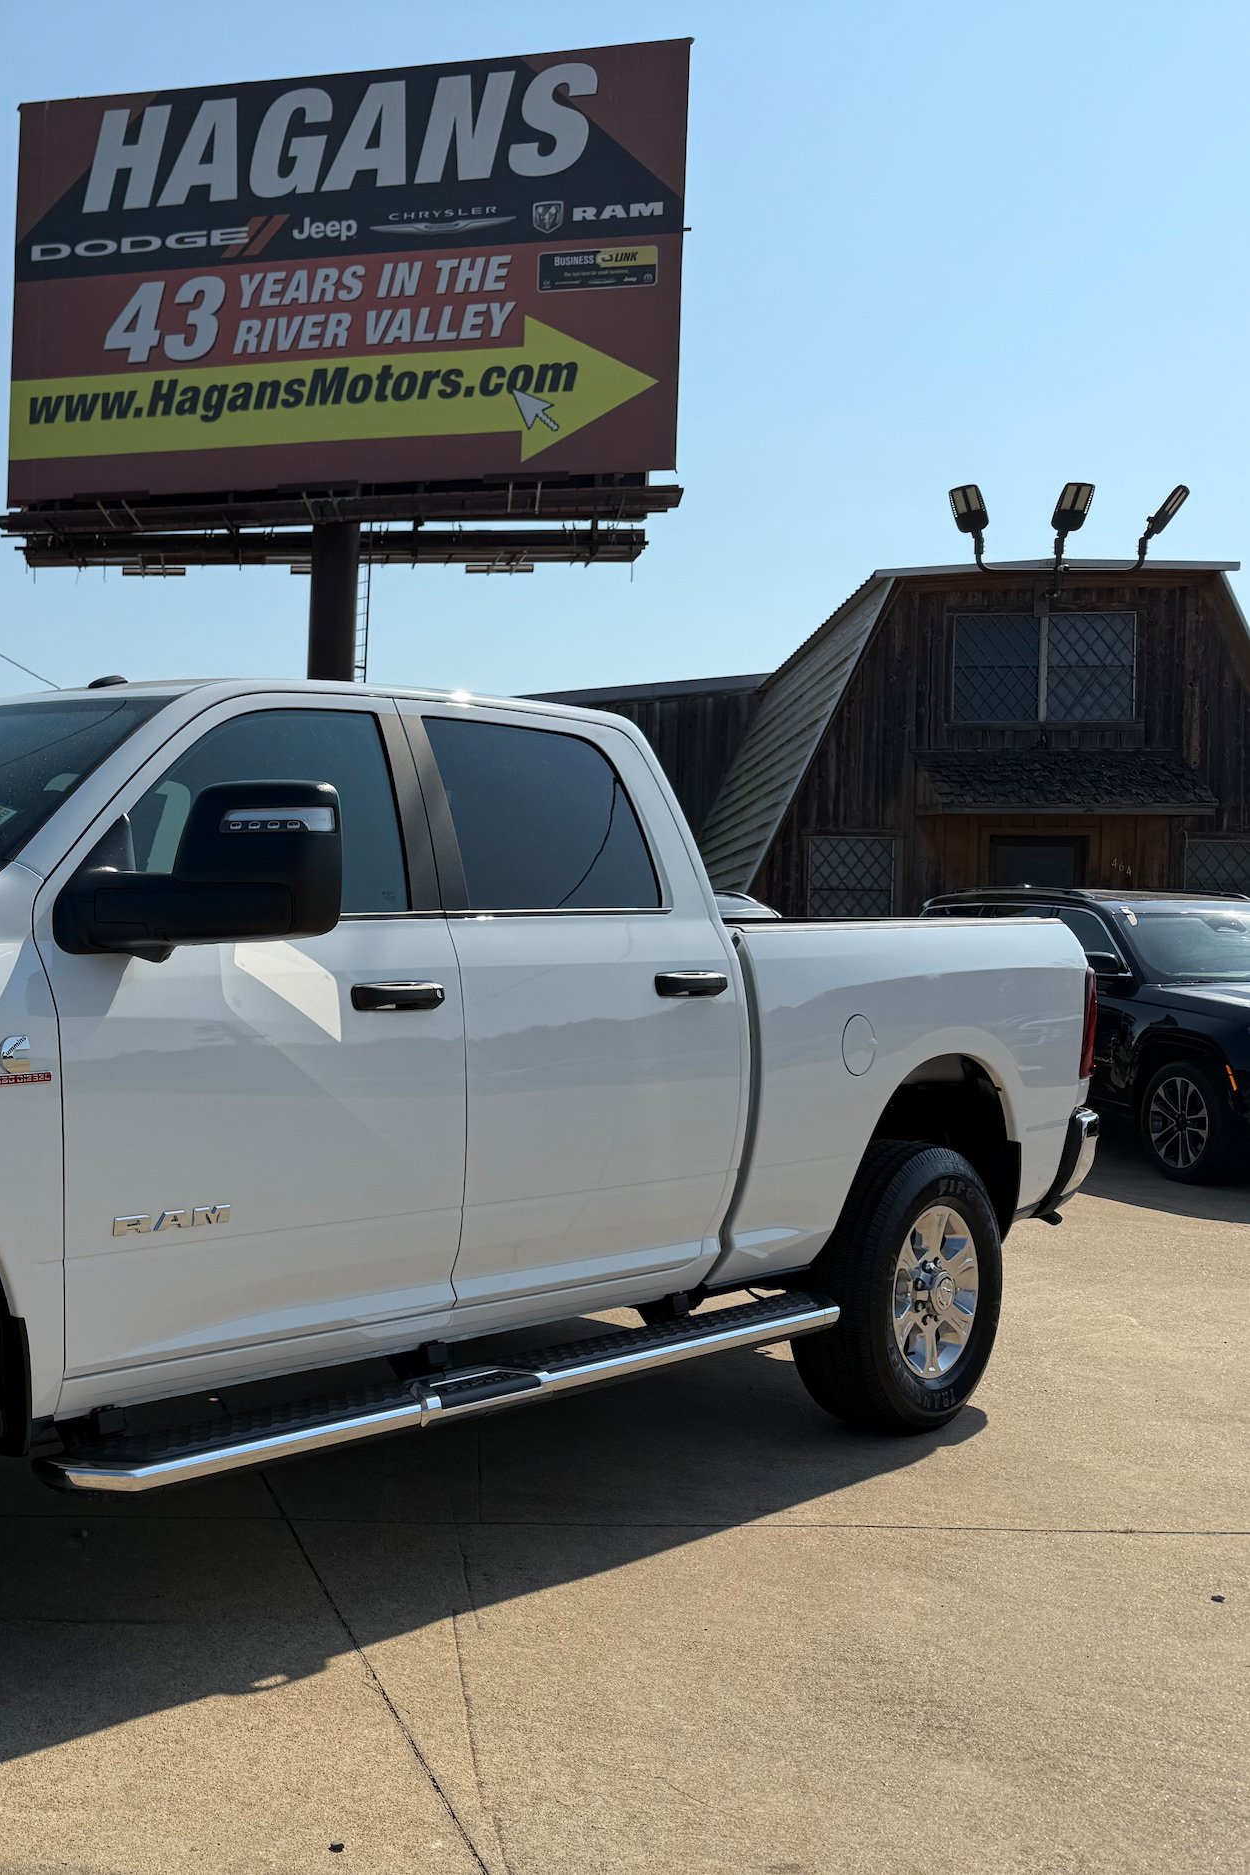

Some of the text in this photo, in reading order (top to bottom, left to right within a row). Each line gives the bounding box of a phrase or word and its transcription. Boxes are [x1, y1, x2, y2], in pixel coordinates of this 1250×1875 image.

[81, 62, 599, 214] HAGANS
[388, 205, 498, 222] CHRYSLER
[572, 201, 664, 221] RAM
[31, 226, 249, 262] DODGE
[292, 216, 358, 242] Jeep
[554, 251, 639, 267] BUSINESS LINK
[238, 255, 512, 309] YEARS IN THE
[103, 275, 226, 364] 43
[233, 301, 517, 355] RIVER VALLEY
[28, 360, 579, 426] www.HagansMotors.com
[1, 1036, 28, 1058] Cummins
[17, 1073, 50, 1082] DIESEL
[113, 1204, 231, 1237] RAM
